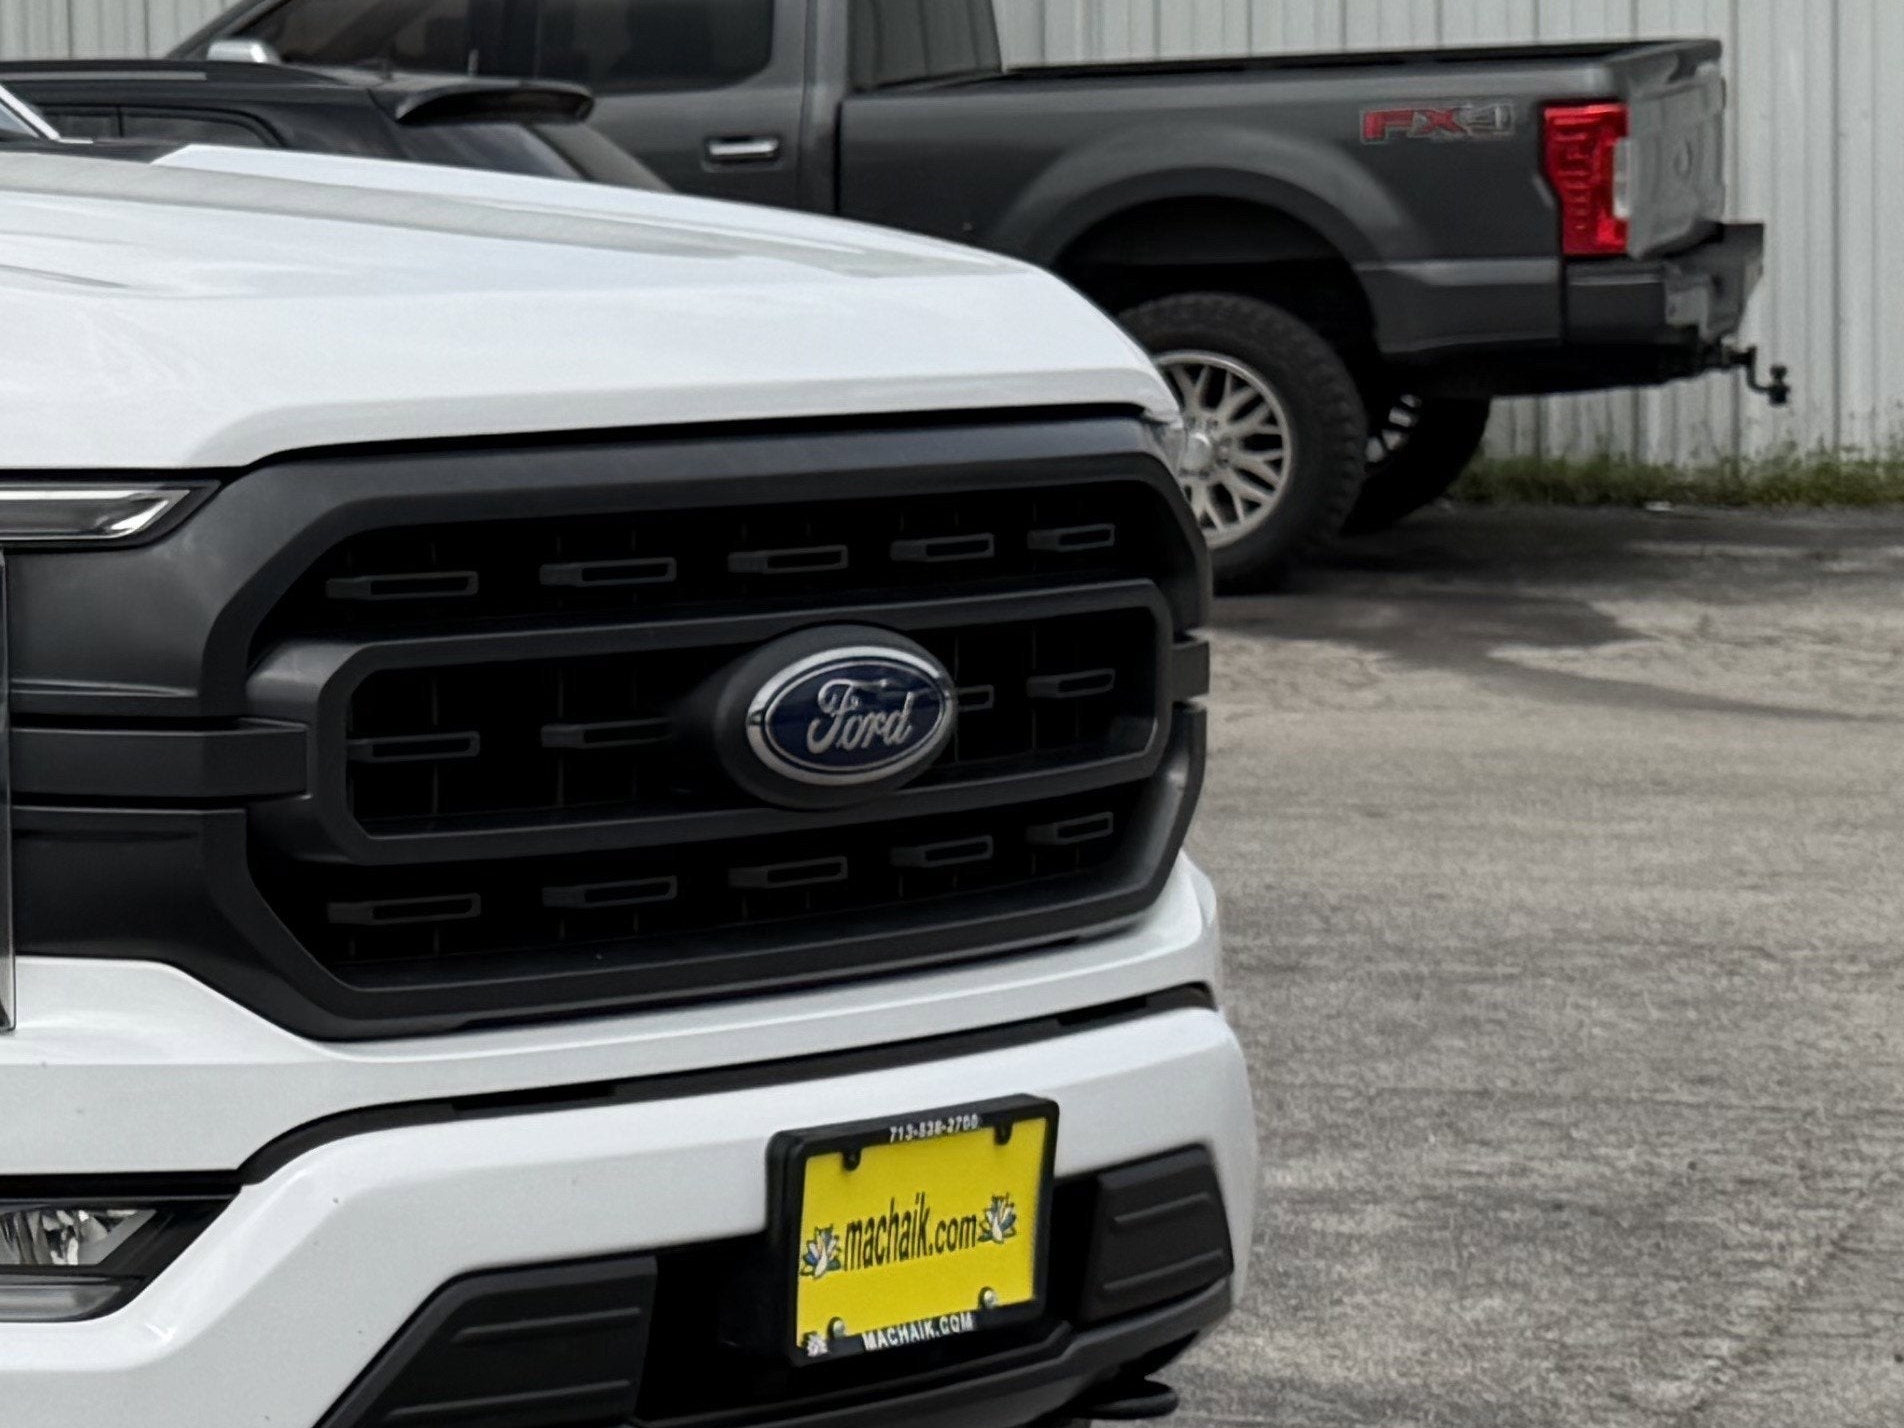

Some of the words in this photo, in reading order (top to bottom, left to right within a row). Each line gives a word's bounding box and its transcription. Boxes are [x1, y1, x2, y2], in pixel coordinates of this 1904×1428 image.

[1360, 103, 1515, 145] FX4
[806, 677, 916, 754] Ford
[843, 1192, 978, 1271] machaik.com
[861, 1312, 973, 1352] MACHAIK.COM
